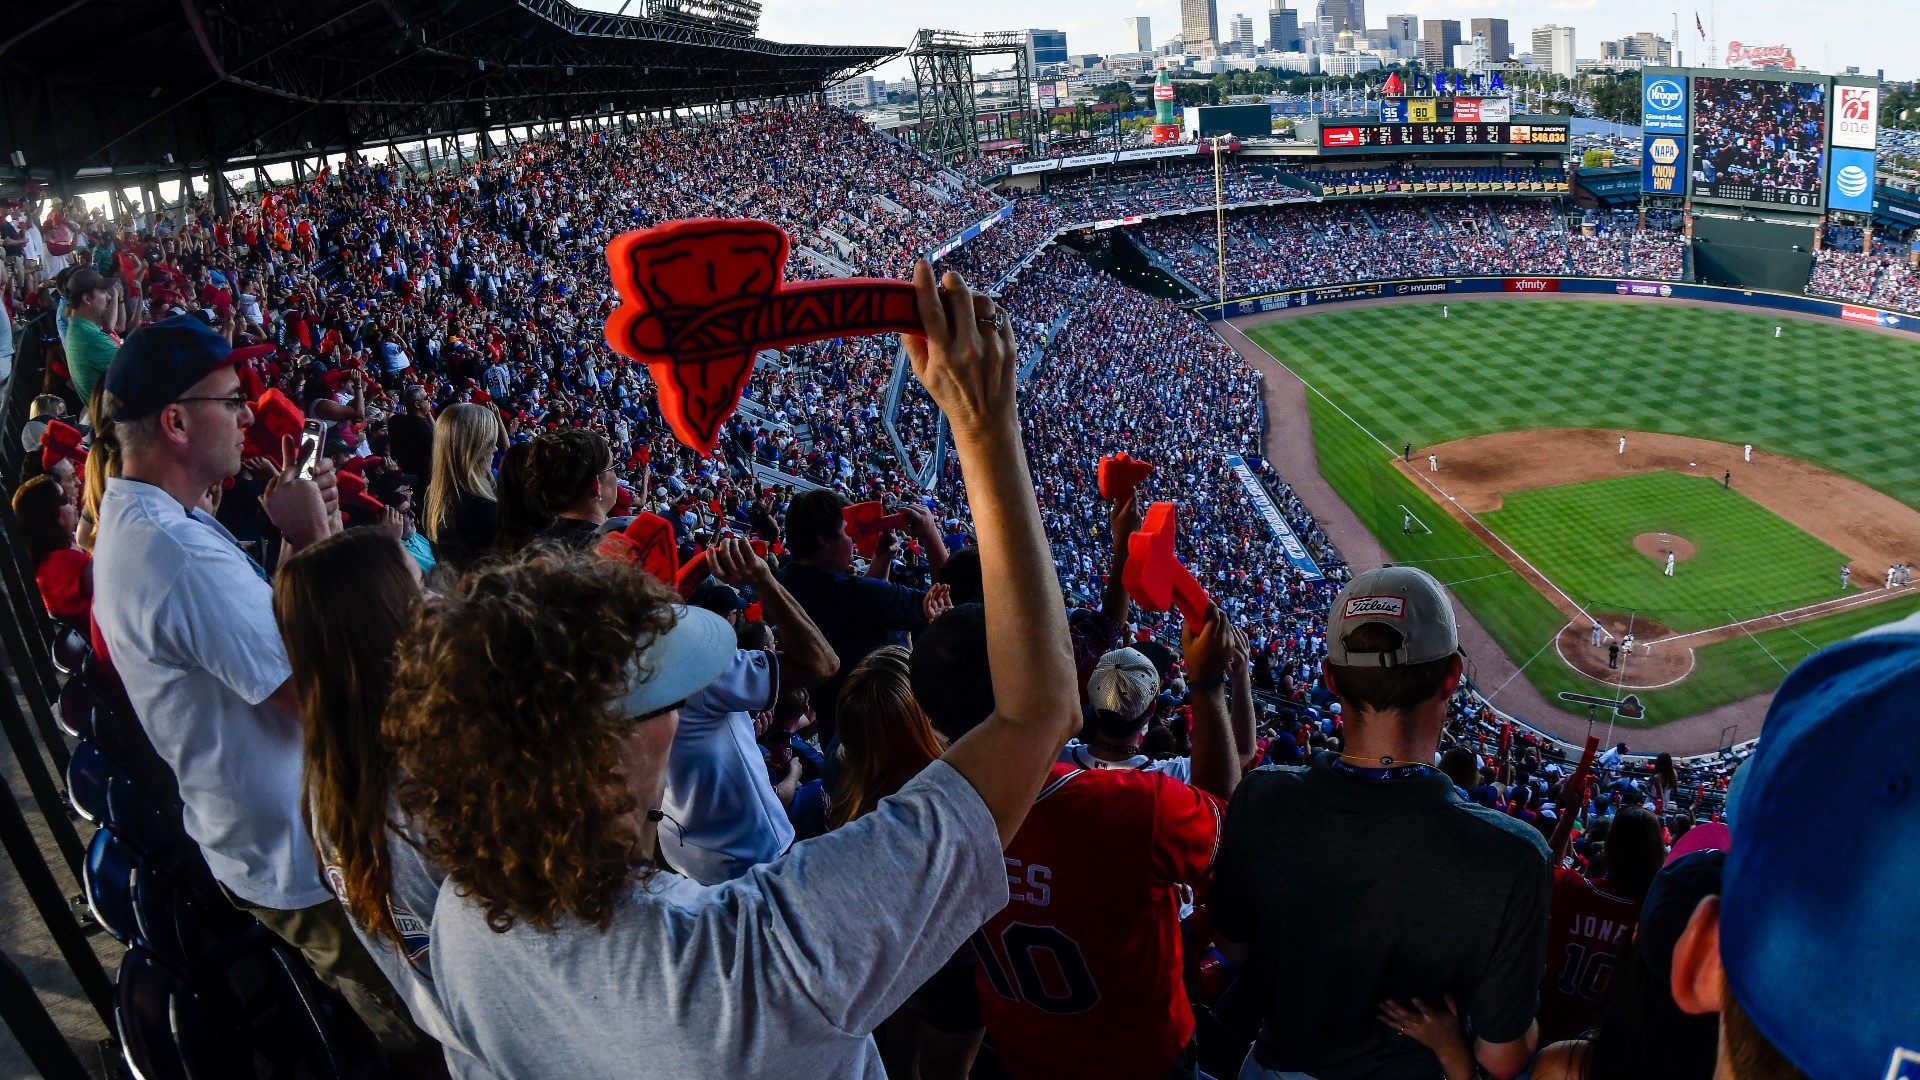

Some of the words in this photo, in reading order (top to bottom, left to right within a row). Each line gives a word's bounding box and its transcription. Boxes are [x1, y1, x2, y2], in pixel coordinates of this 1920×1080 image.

[1725, 41, 1785, 65] Braves
[1413, 73, 1504, 91] DELTA
[1651, 85, 1679, 106] Kroger
[1382, 107, 1398, 118] $35
[1413, 107, 1428, 118] $80
[1840, 121, 1869, 133] one
[1531, 133, 1566, 143] $46,034
[1654, 145, 1675, 158] NAPA
[1651, 165, 1676, 178] KNOW
[1653, 178, 1673, 190] HOW
[1790, 194, 1798, 204] 0
[1800, 196, 1808, 205] 0
[1812, 197, 1817, 206] 1
[1411, 284, 1446, 292] HYUNDAI
[1515, 280, 1547, 290] xfinity
[1260, 296, 1273, 305] HOME
[1273, 294, 1290, 303] GAMES
[1262, 301, 1288, 311] REMAINING
[1260, 505, 1290, 535] TURNER
[1278, 534, 1306, 559] FIELD
[1347, 598, 1400, 614] Titleist
[1003, 857, 1052, 906] ES
[1569, 914, 1628, 945] JONE
[970, 921, 1102, 1015] 10
